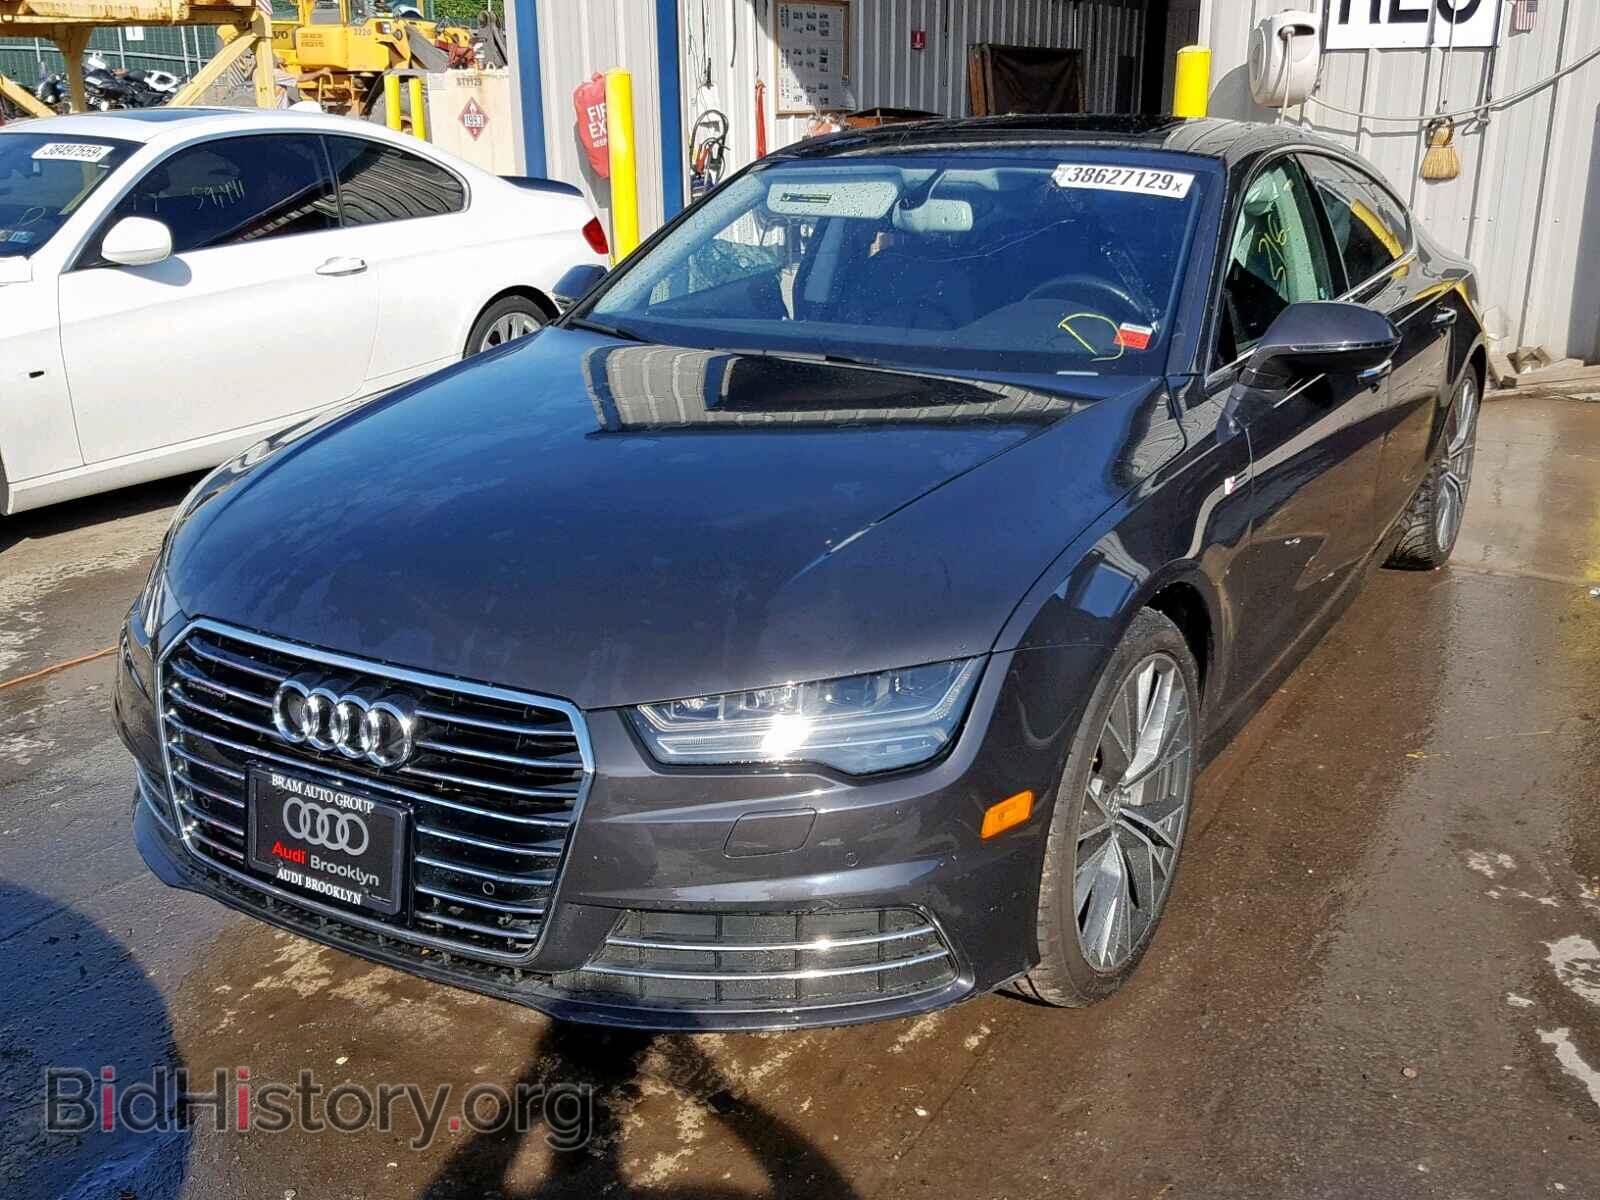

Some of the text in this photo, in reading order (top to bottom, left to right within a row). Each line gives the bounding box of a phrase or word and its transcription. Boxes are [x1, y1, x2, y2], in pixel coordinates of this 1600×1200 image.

[272, 774, 375, 813] BRAM AUTO GROUP
[271, 839, 380, 886] Audi Brooklyn
[276, 867, 362, 905] AUDI BROOKLYN
